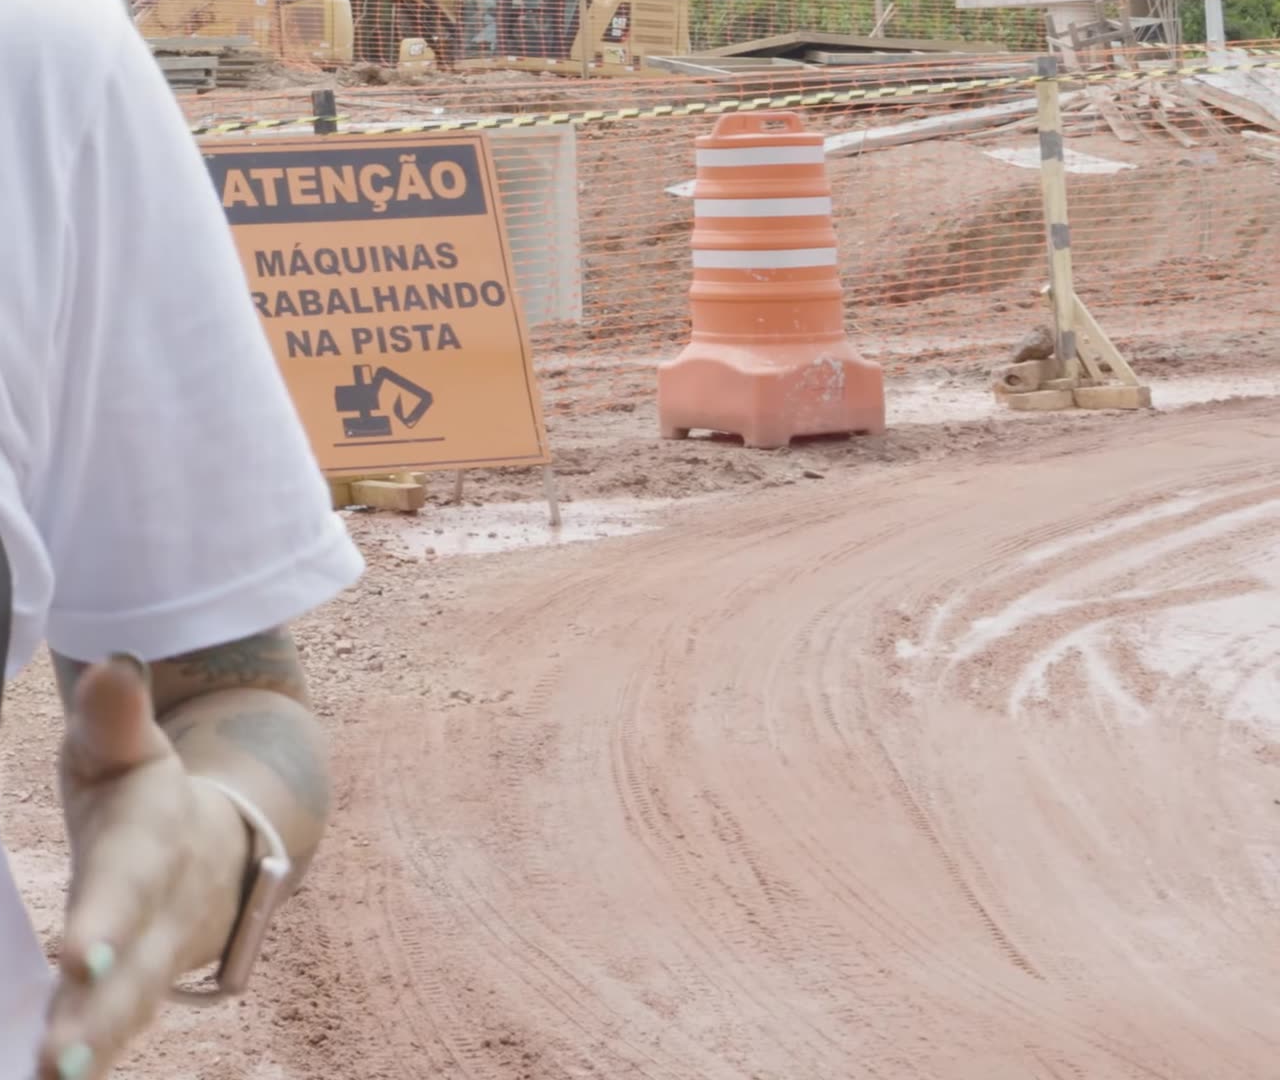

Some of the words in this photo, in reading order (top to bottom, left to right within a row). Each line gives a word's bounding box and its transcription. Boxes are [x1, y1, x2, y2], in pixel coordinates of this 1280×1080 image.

[222, 154, 467, 212] ATENÇÃO
[254, 242, 458, 278] MÁQUINAS
[250, 280, 506, 318] RABALHANDO
[285, 329, 341, 358] NA
[351, 323, 462, 355] PISTA
